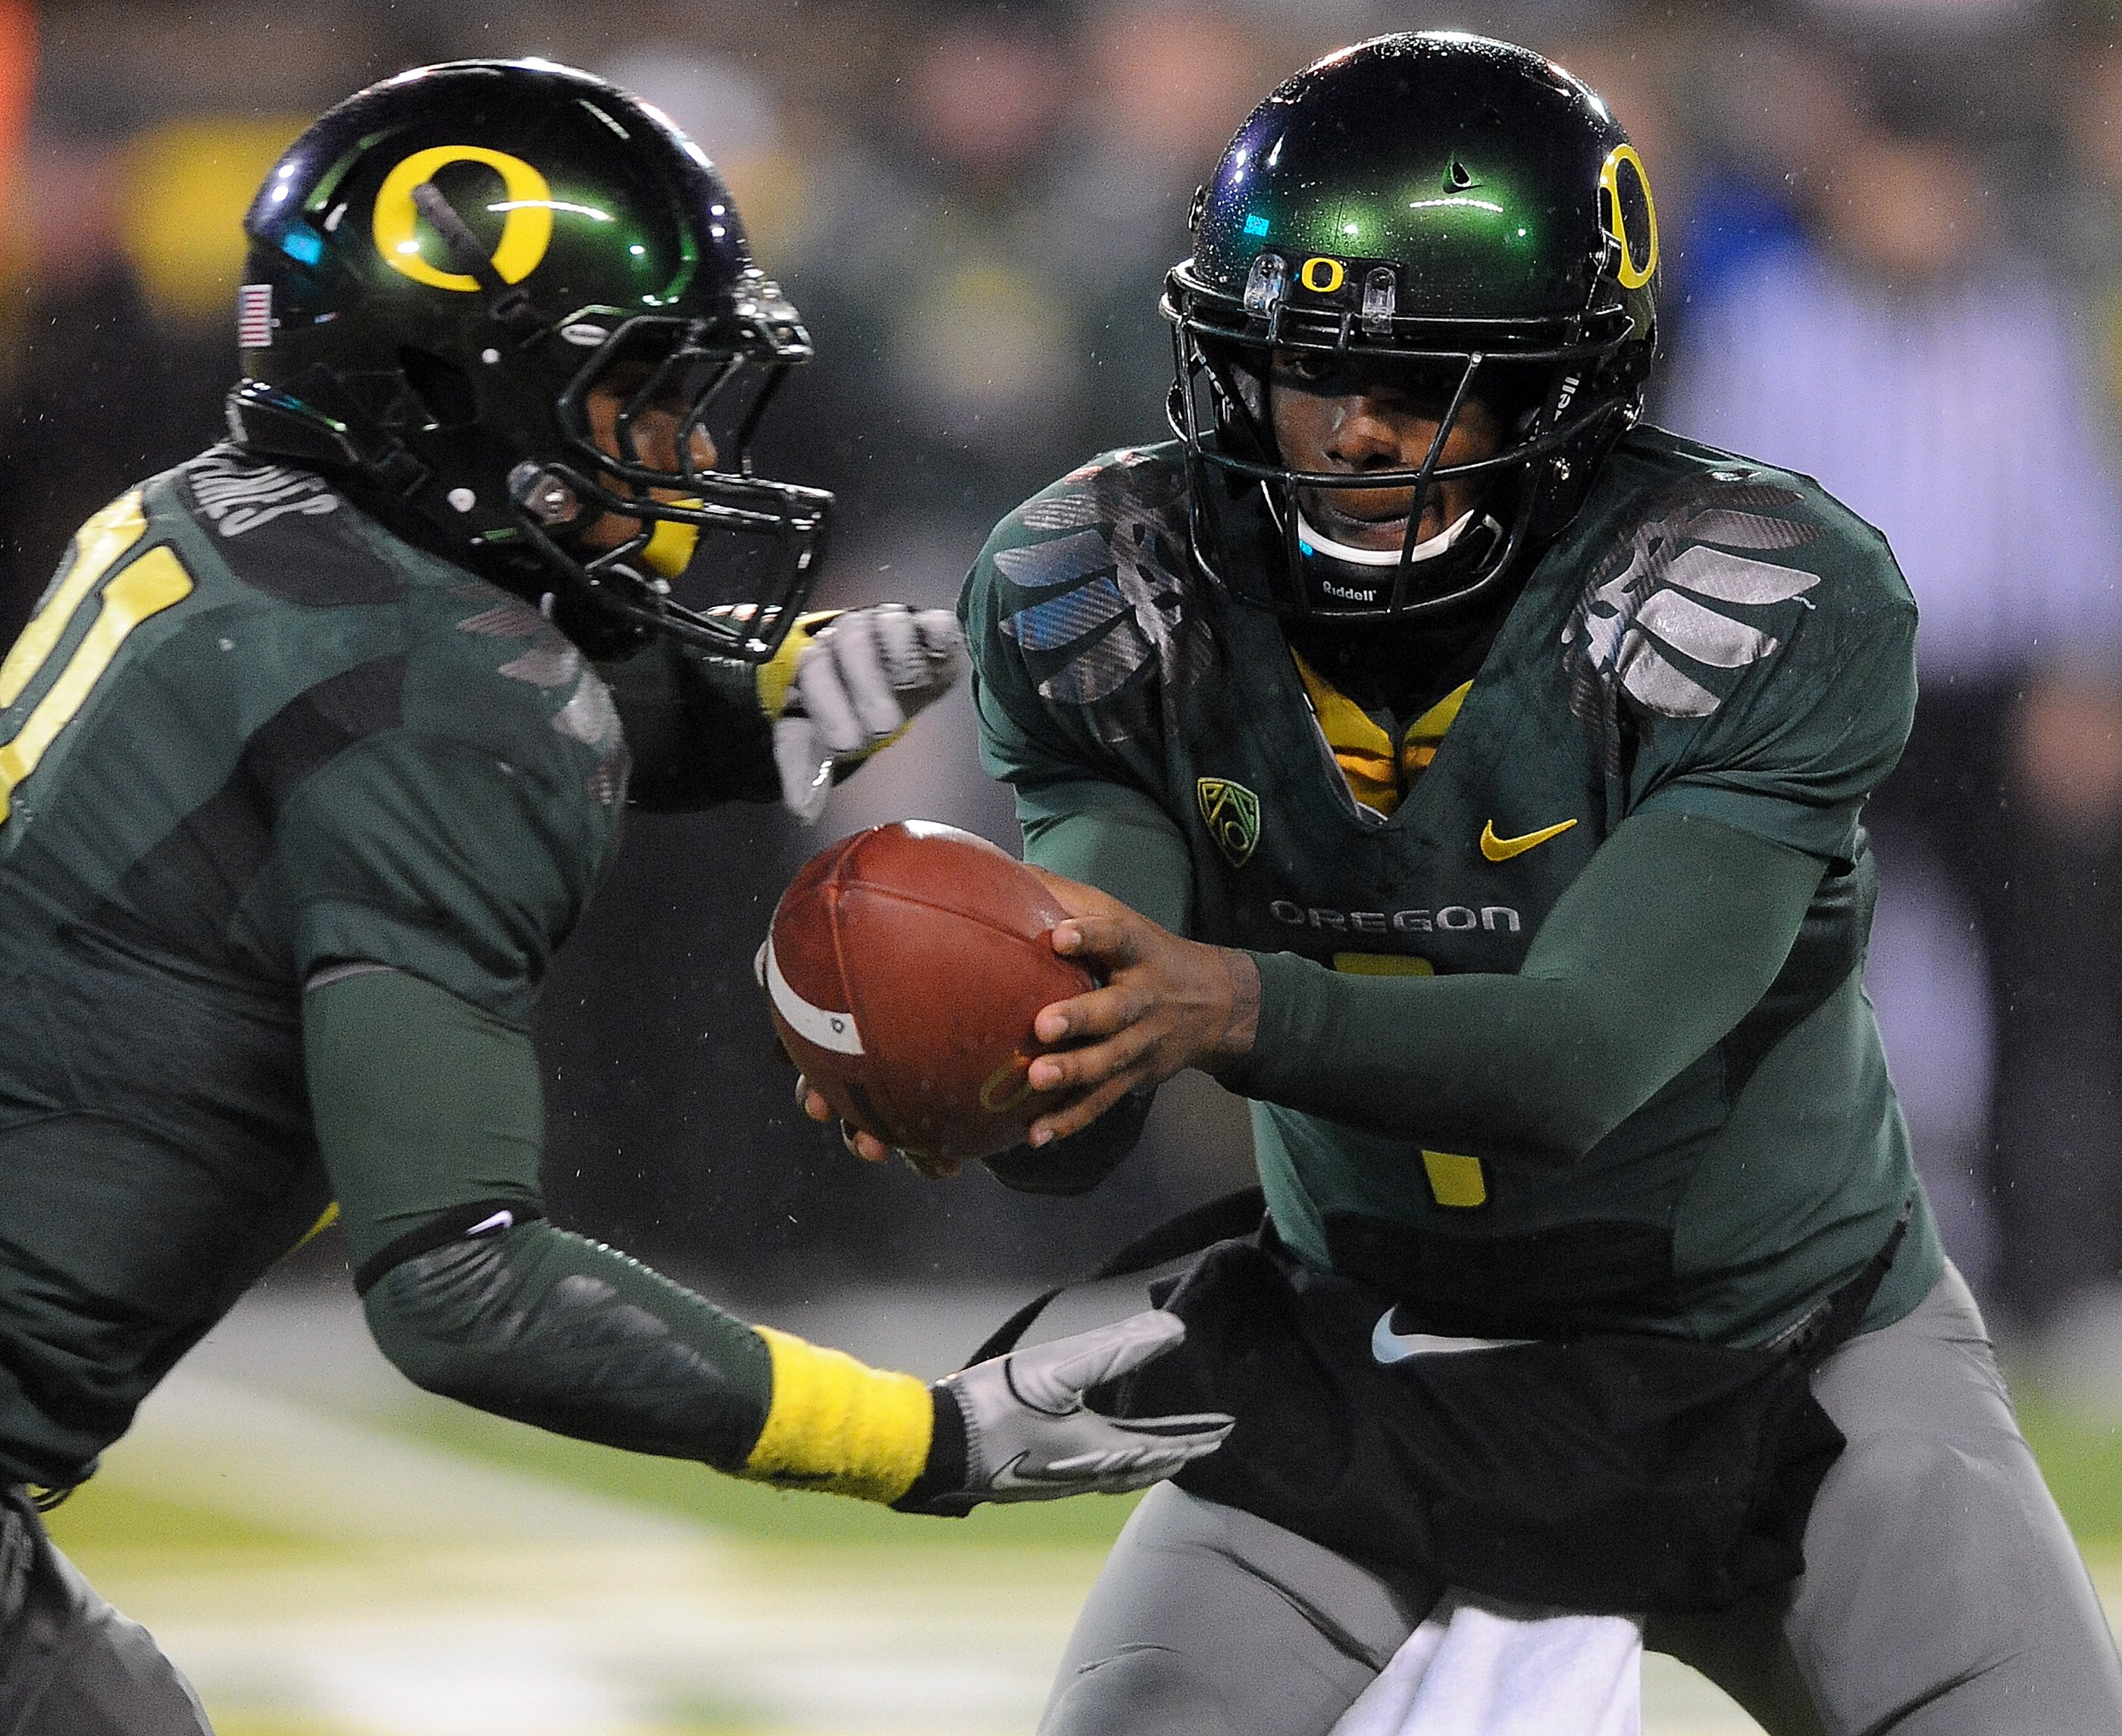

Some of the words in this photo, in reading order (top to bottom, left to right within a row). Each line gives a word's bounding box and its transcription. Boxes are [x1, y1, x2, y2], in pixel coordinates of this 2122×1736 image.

[1301, 258, 1344, 292] O
[1323, 580, 1373, 601] Riddell
[1269, 900, 1520, 932] OREGON
